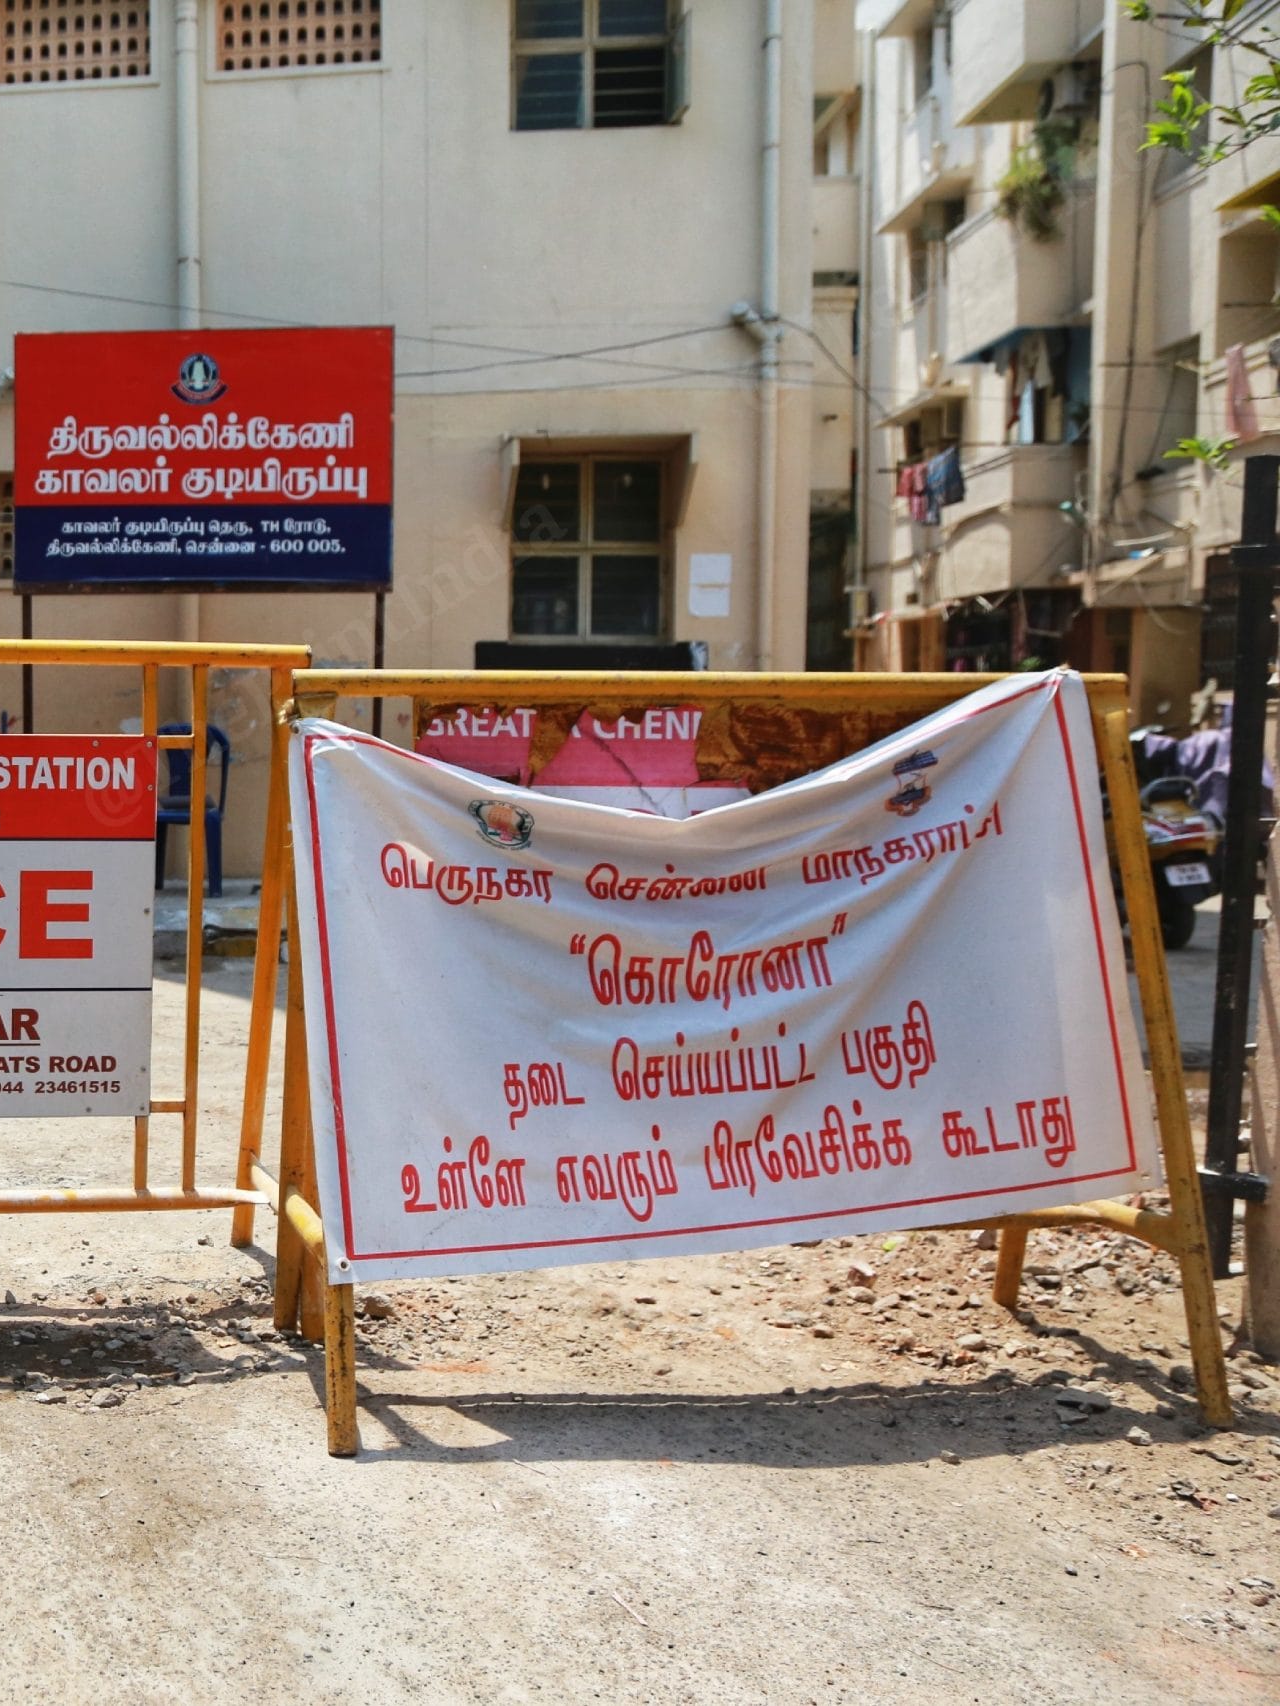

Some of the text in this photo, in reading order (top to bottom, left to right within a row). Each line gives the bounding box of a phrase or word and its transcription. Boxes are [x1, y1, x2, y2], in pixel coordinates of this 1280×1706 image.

[46, 412, 355, 459] திருவல்லிக்கேணி
[34, 455, 368, 500] காவலர் குடியிருப்பு
[62, 516, 121, 534] காவலர்
[125, 516, 205, 536] குடியிருப்பு
[261, 520, 280, 533] TH
[186, 537, 256, 553] சென்னை
[270, 538, 304, 553] 600
[380, 842, 554, 905] பெருநகர
[49, 1055, 117, 1073] ROAD
[504, 1062, 585, 1130] தடை
[842, 1000, 937, 1089] பகுதி
[35, 1080, 121, 1094] 23461515
[401, 1095, 1077, 1222] உள்ளே எவரும் பிரவேசிக்க கூடாது
